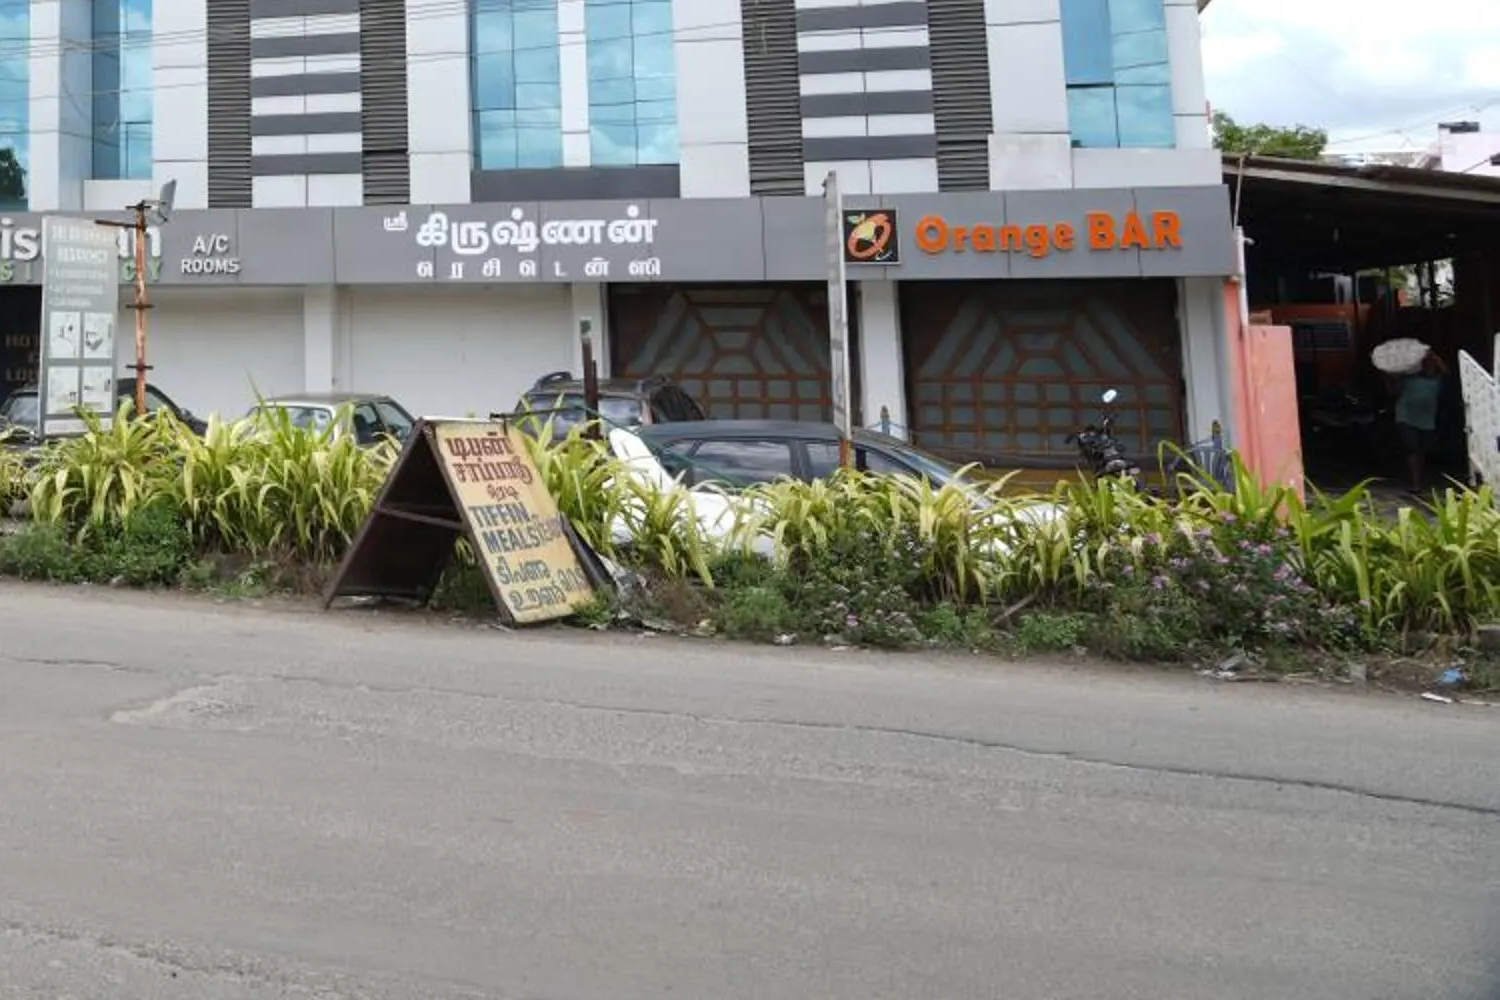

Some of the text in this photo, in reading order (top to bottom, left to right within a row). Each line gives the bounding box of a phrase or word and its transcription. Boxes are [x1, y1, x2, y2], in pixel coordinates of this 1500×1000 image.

[415, 204, 658, 255] கிருஷ்ணன்
[914, 209, 1183, 257] Orange BAR
[193, 233, 229, 257] A/C
[181, 258, 241, 274] ROOMS
[469, 502, 530, 528] TIFFIN
[481, 526, 541, 554] MEALS
